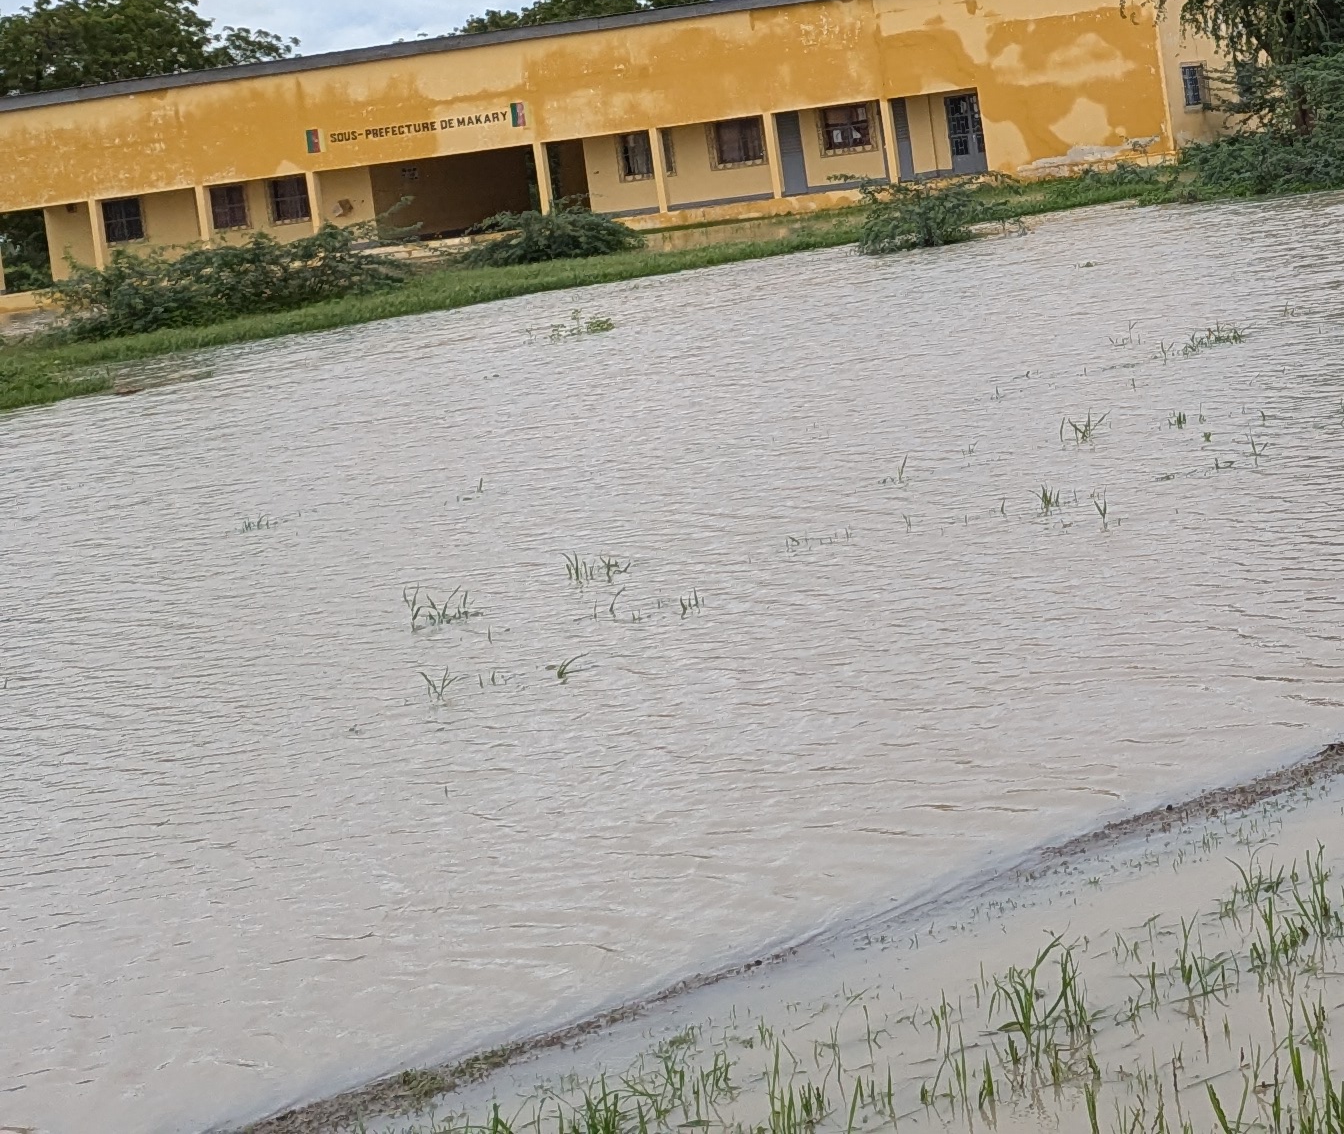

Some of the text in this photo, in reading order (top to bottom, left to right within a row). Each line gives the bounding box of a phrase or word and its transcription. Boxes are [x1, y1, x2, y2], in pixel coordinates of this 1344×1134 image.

[329, 111, 508, 143] SOUS-PREFECTURE DE MAKARY
